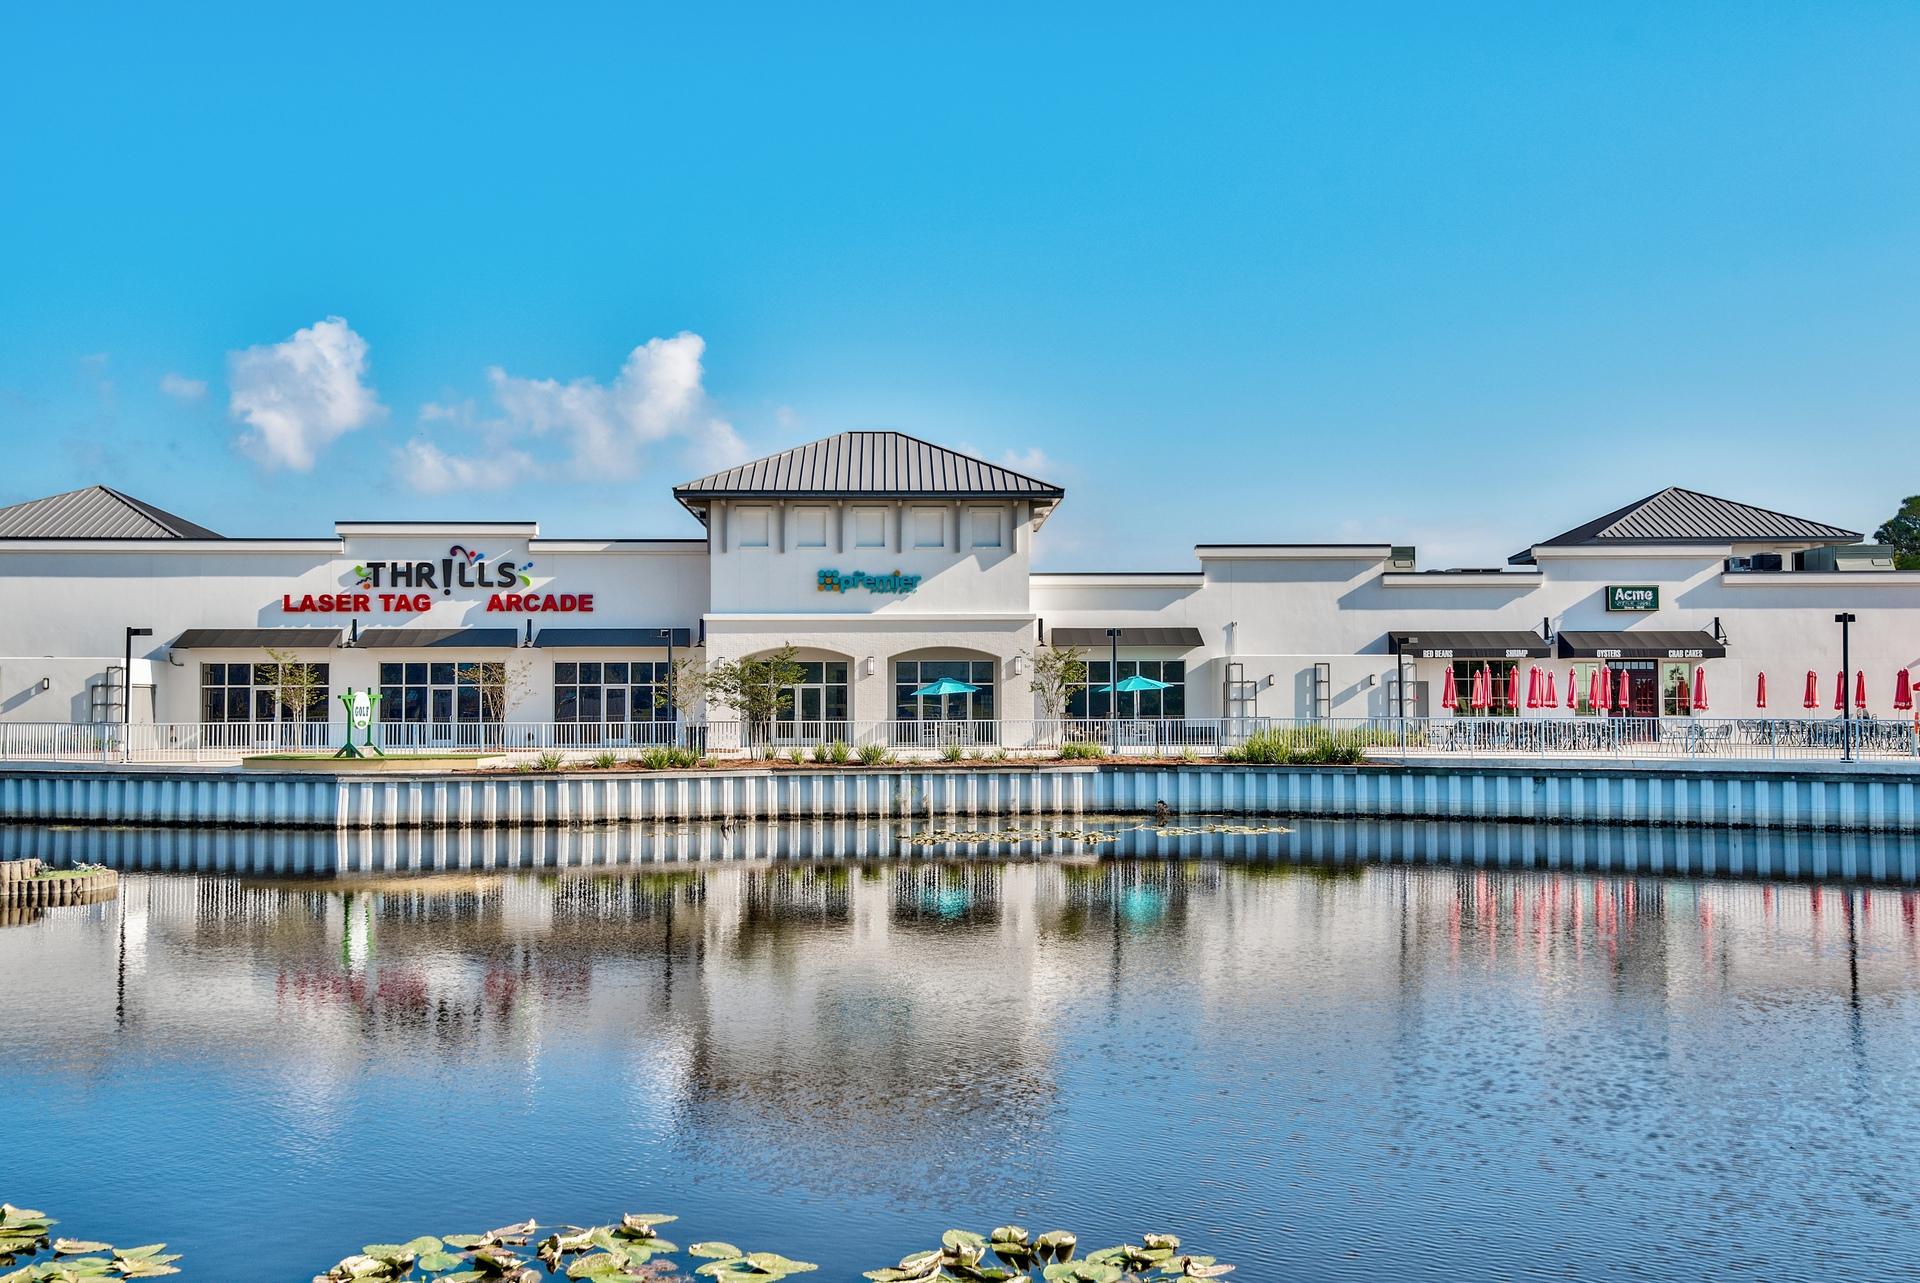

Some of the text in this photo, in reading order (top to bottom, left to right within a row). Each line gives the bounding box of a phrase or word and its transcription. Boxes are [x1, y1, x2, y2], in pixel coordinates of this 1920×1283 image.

[840, 569, 922, 594] premier
[1615, 588, 1653, 601] Acme
[283, 594, 432, 612] LASER TAG
[486, 594, 594, 612] ARCADE
[1422, 649, 1453, 658] RED BEANS
[1505, 649, 1528, 658] SHRIMP
[1596, 649, 1621, 658] OYSTERS
[1668, 649, 1703, 658] CRAB CAKES
[355, 706, 369, 717] GOLF
